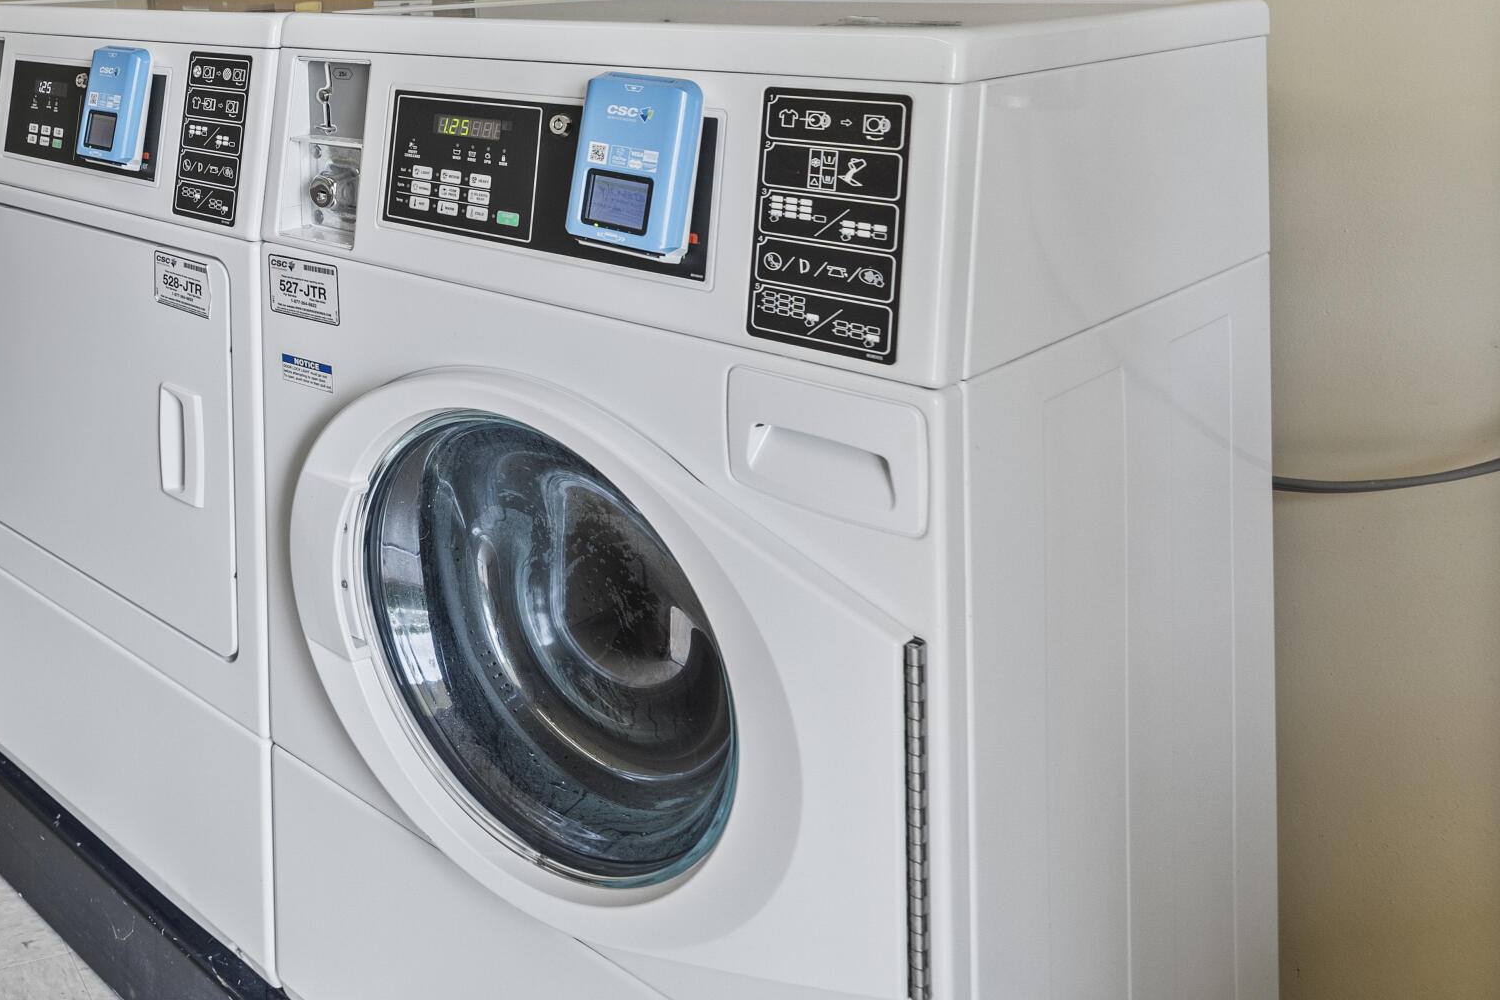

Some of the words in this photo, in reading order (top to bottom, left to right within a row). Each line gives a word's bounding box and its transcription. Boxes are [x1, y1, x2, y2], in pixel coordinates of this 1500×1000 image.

[100, 66, 114, 74] CSC
[607, 105, 638, 117] CSC
[157, 255, 170, 264] CSC
[271, 259, 287, 267] CSC
[163, 274, 202, 295] 528-JTR
[280, 279, 326, 300] 527-JTR
[293, 358, 319, 370] NOTICE
